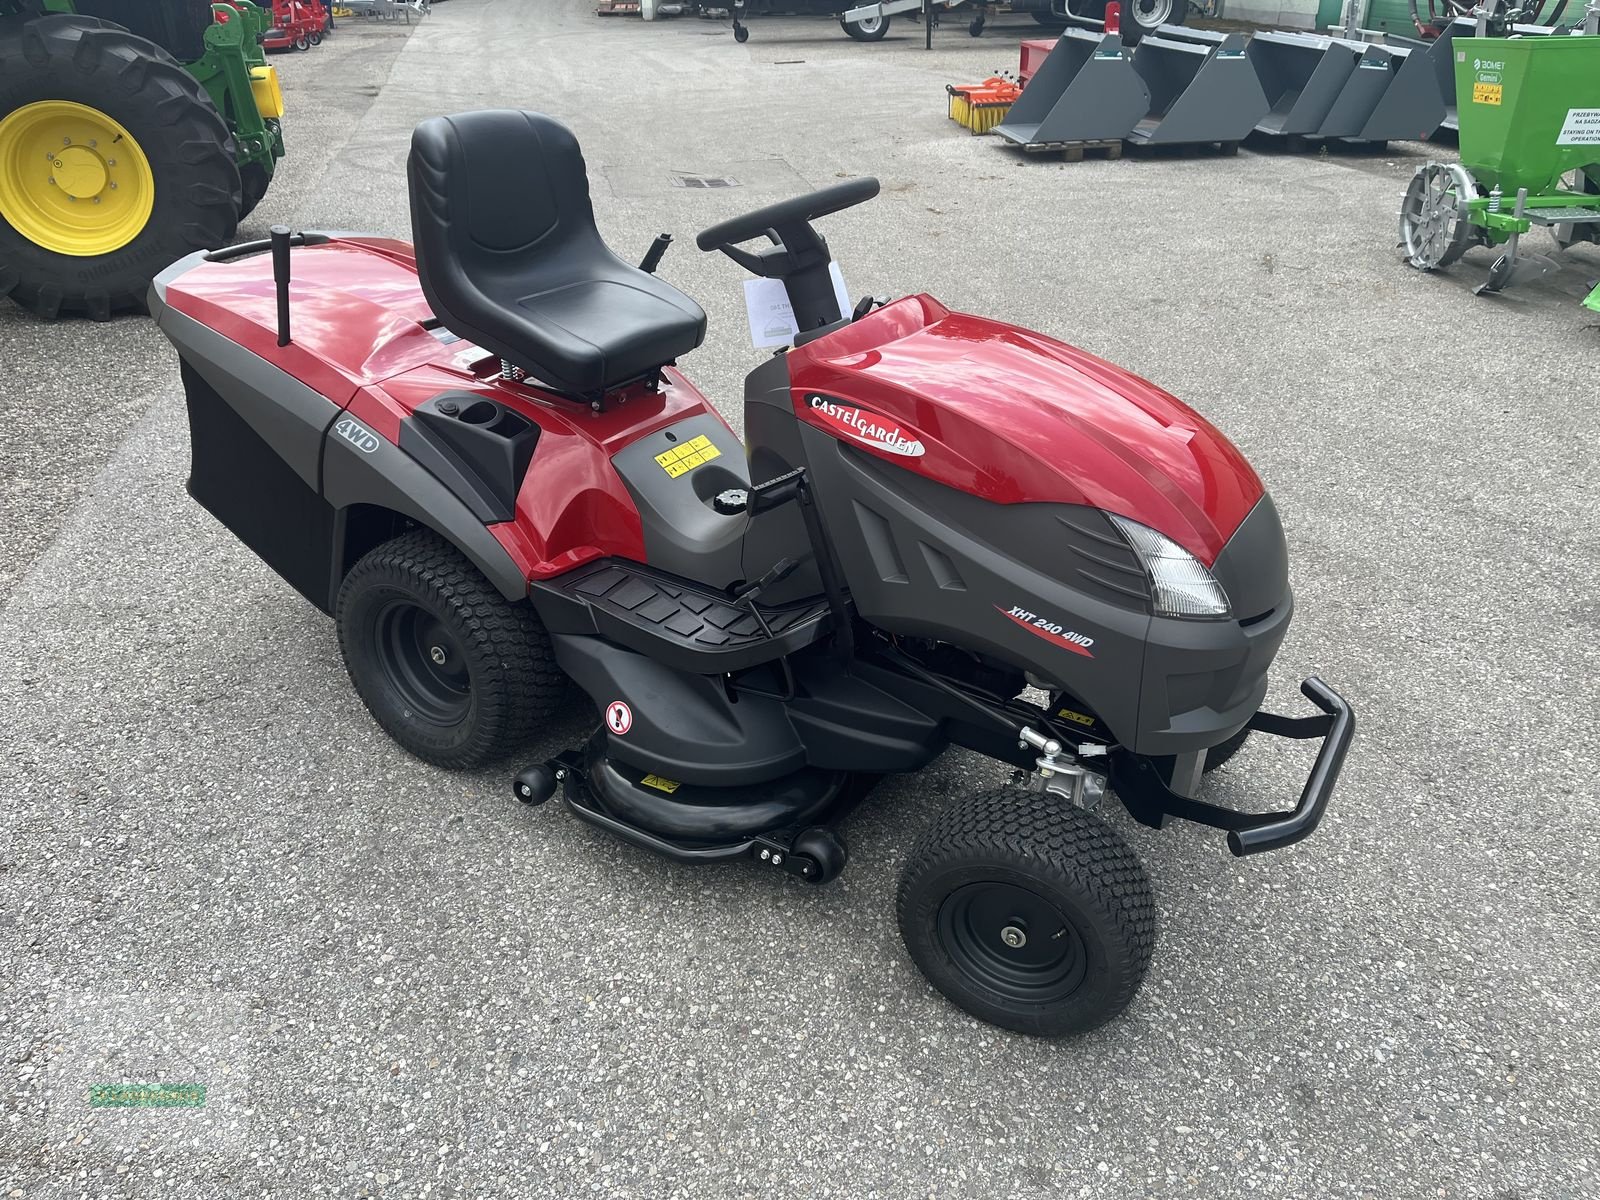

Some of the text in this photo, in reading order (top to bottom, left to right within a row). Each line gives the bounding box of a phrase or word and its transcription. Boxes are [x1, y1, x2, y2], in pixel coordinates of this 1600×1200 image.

[1481, 60, 1505, 70] BOMET
[1480, 73, 1498, 82] Gemini
[335, 419, 379, 453] 4WD
[1007, 605, 1094, 648] XHT 240 4WD
